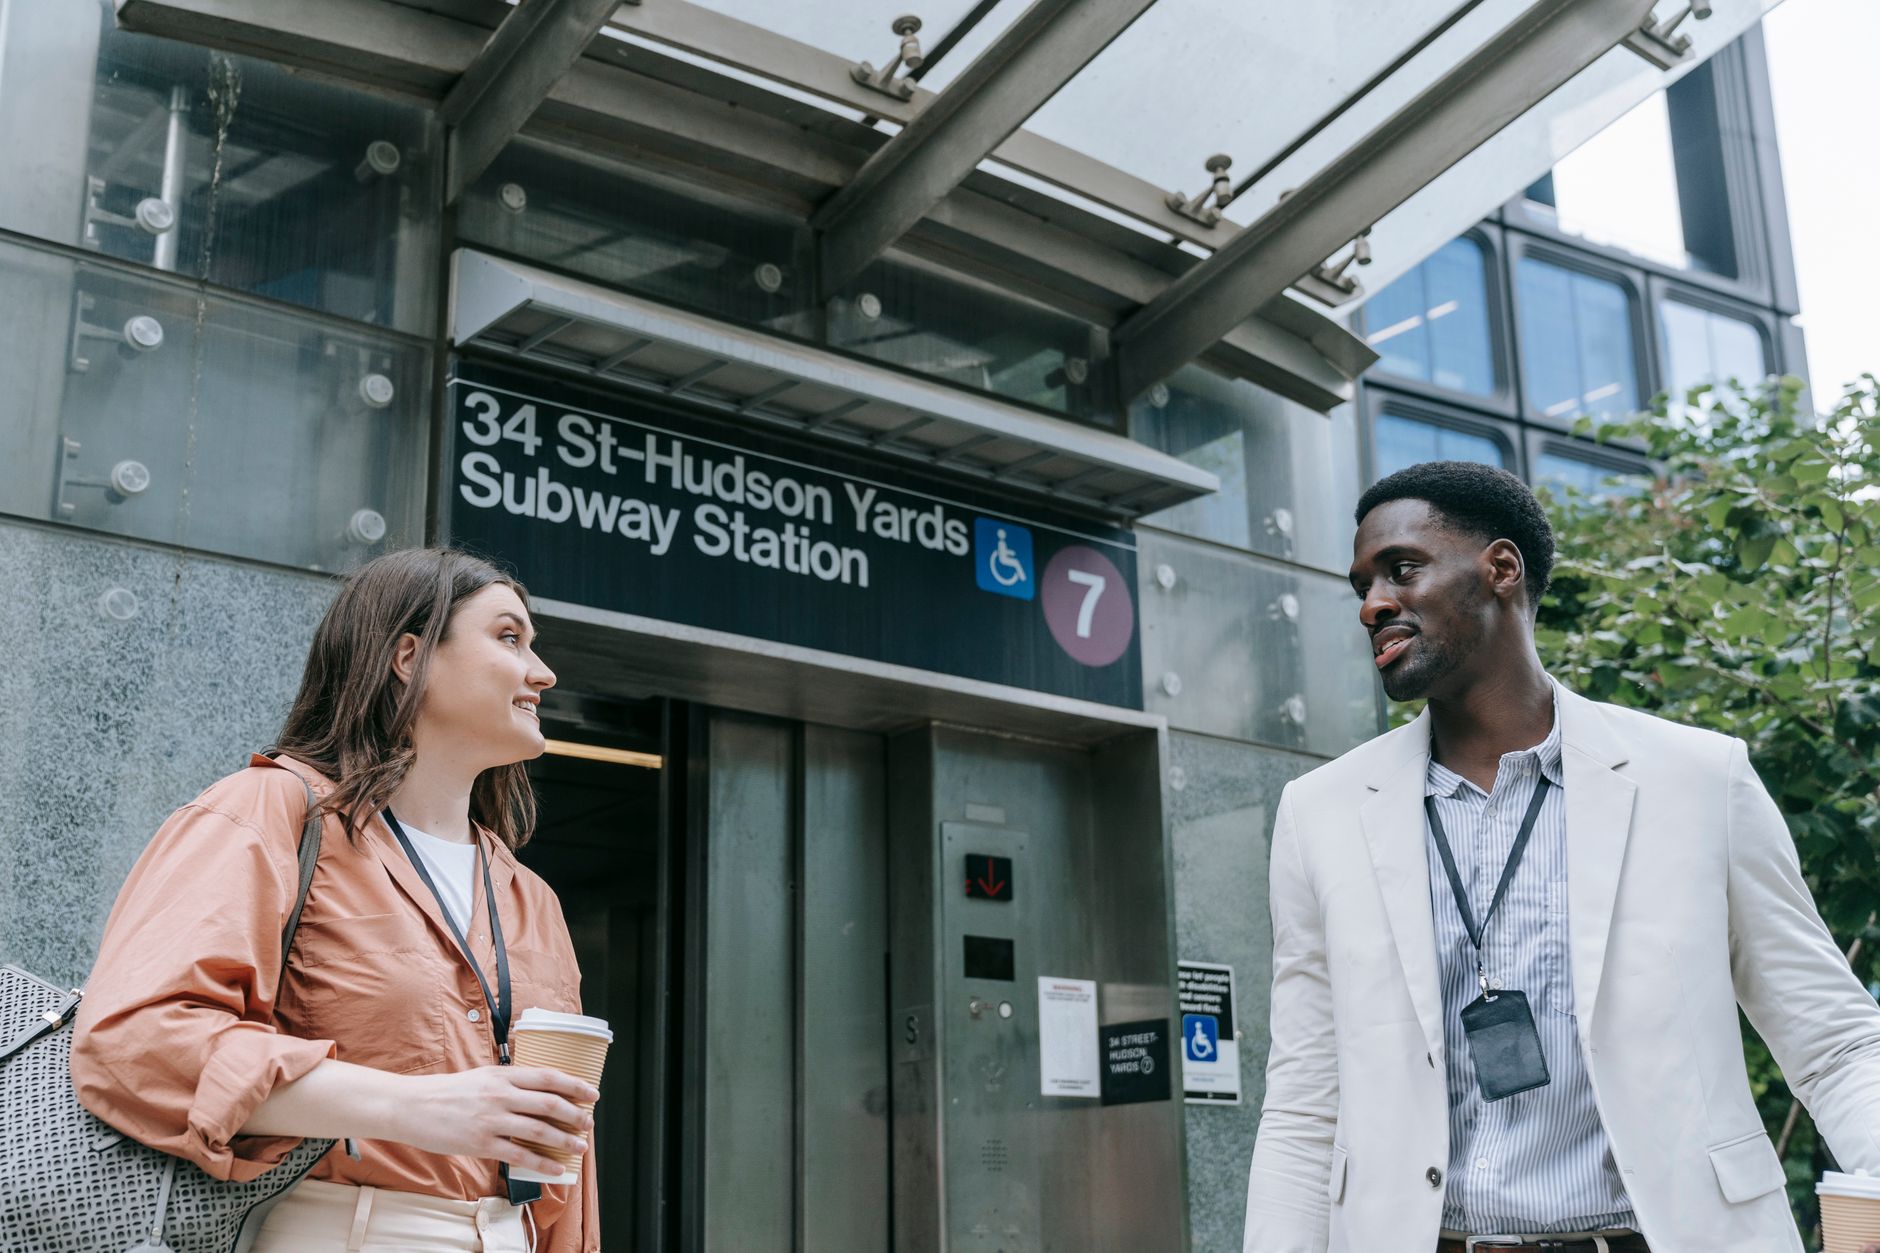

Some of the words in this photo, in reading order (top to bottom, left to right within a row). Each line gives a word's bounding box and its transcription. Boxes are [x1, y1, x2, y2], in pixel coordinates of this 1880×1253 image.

[462, 391, 543, 457] 34
[843, 482, 970, 557] Yards
[459, 451, 681, 556] Subway
[693, 503, 869, 588] Station
[1068, 568, 1106, 639] 7
[1109, 1047, 1147, 1060] HUDSON
[1110, 1061, 1140, 1074] YARDS
